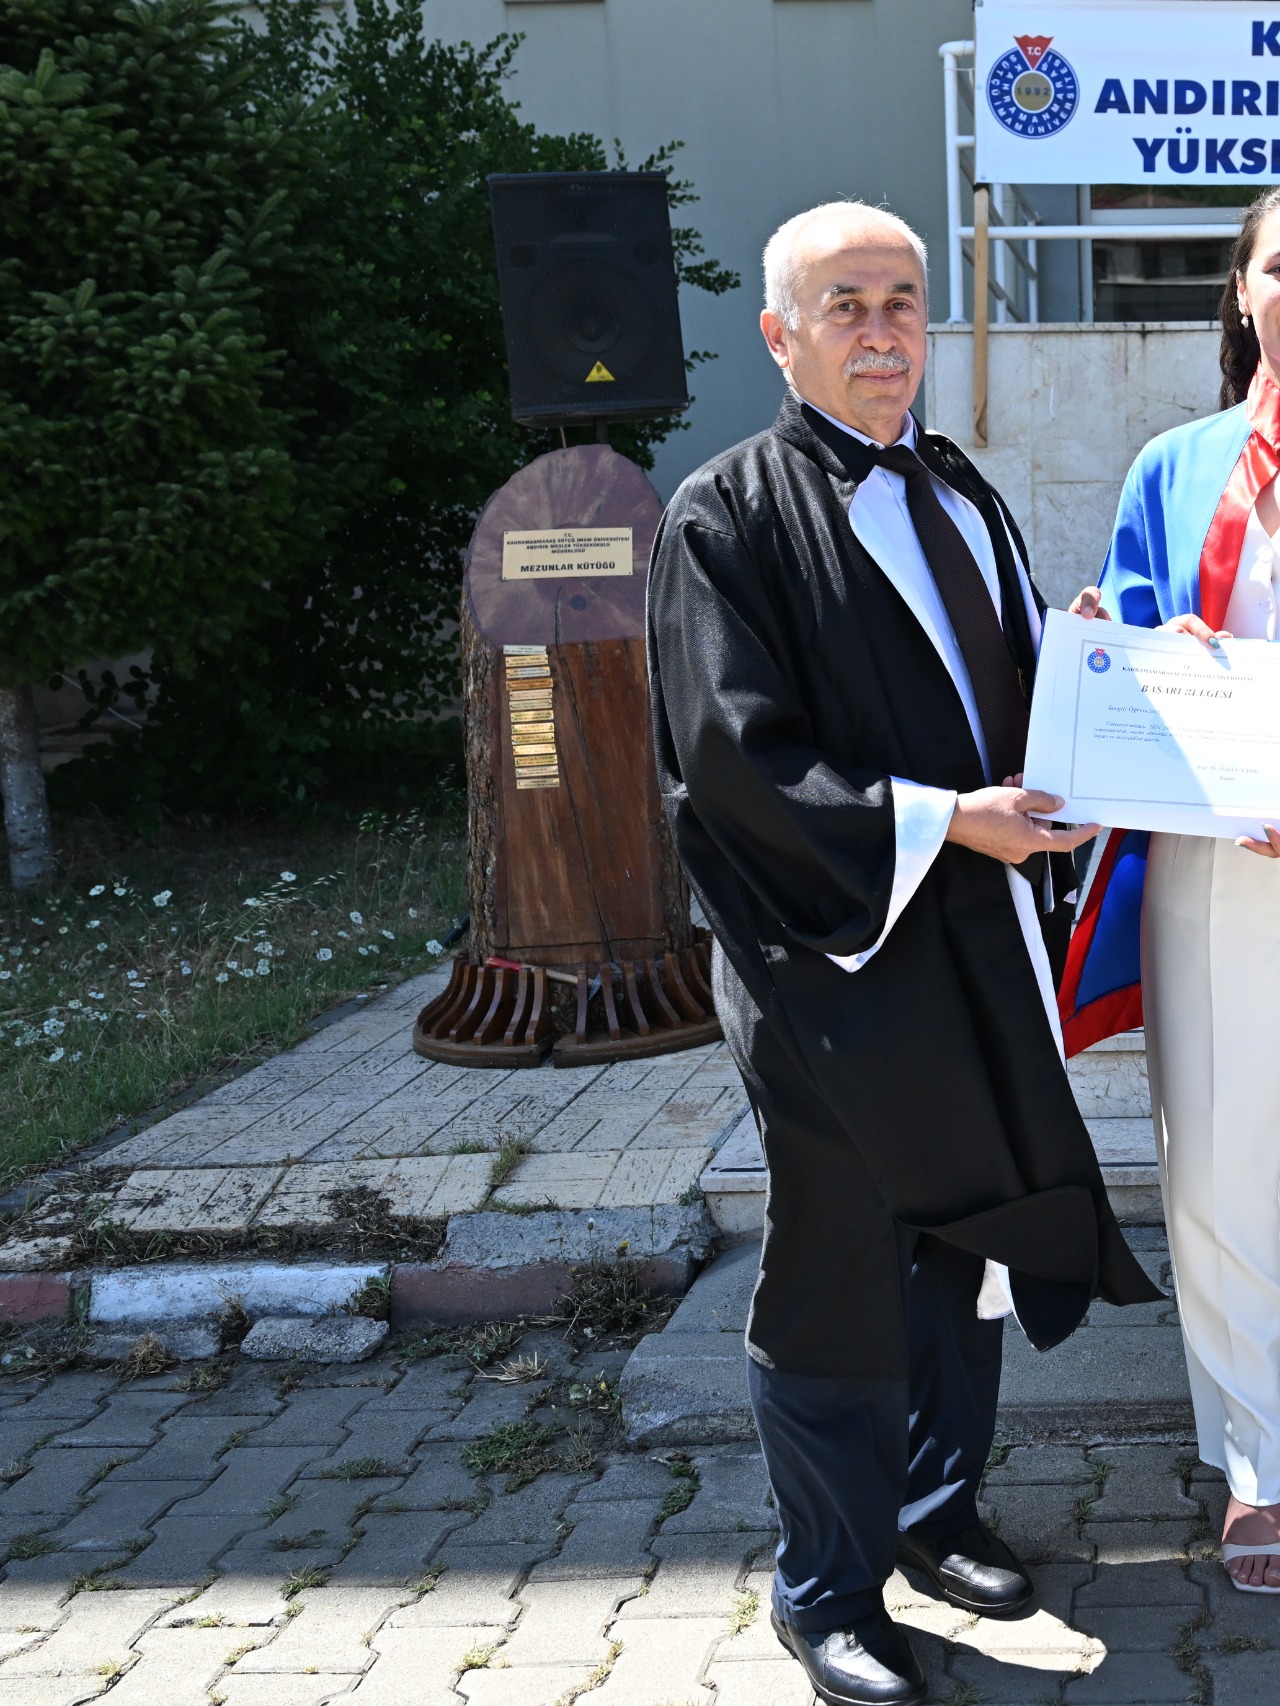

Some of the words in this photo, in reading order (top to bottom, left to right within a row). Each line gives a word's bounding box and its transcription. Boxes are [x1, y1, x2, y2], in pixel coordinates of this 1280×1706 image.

[1016, 87, 1051, 96] 1992
[520, 562, 574, 572] MEZUNLAR
[577, 560, 616, 570] KÜTÜĞÜ
[1141, 684, 1182, 695] BAŞARI
[1185, 688, 1233, 699] BELGESİ
